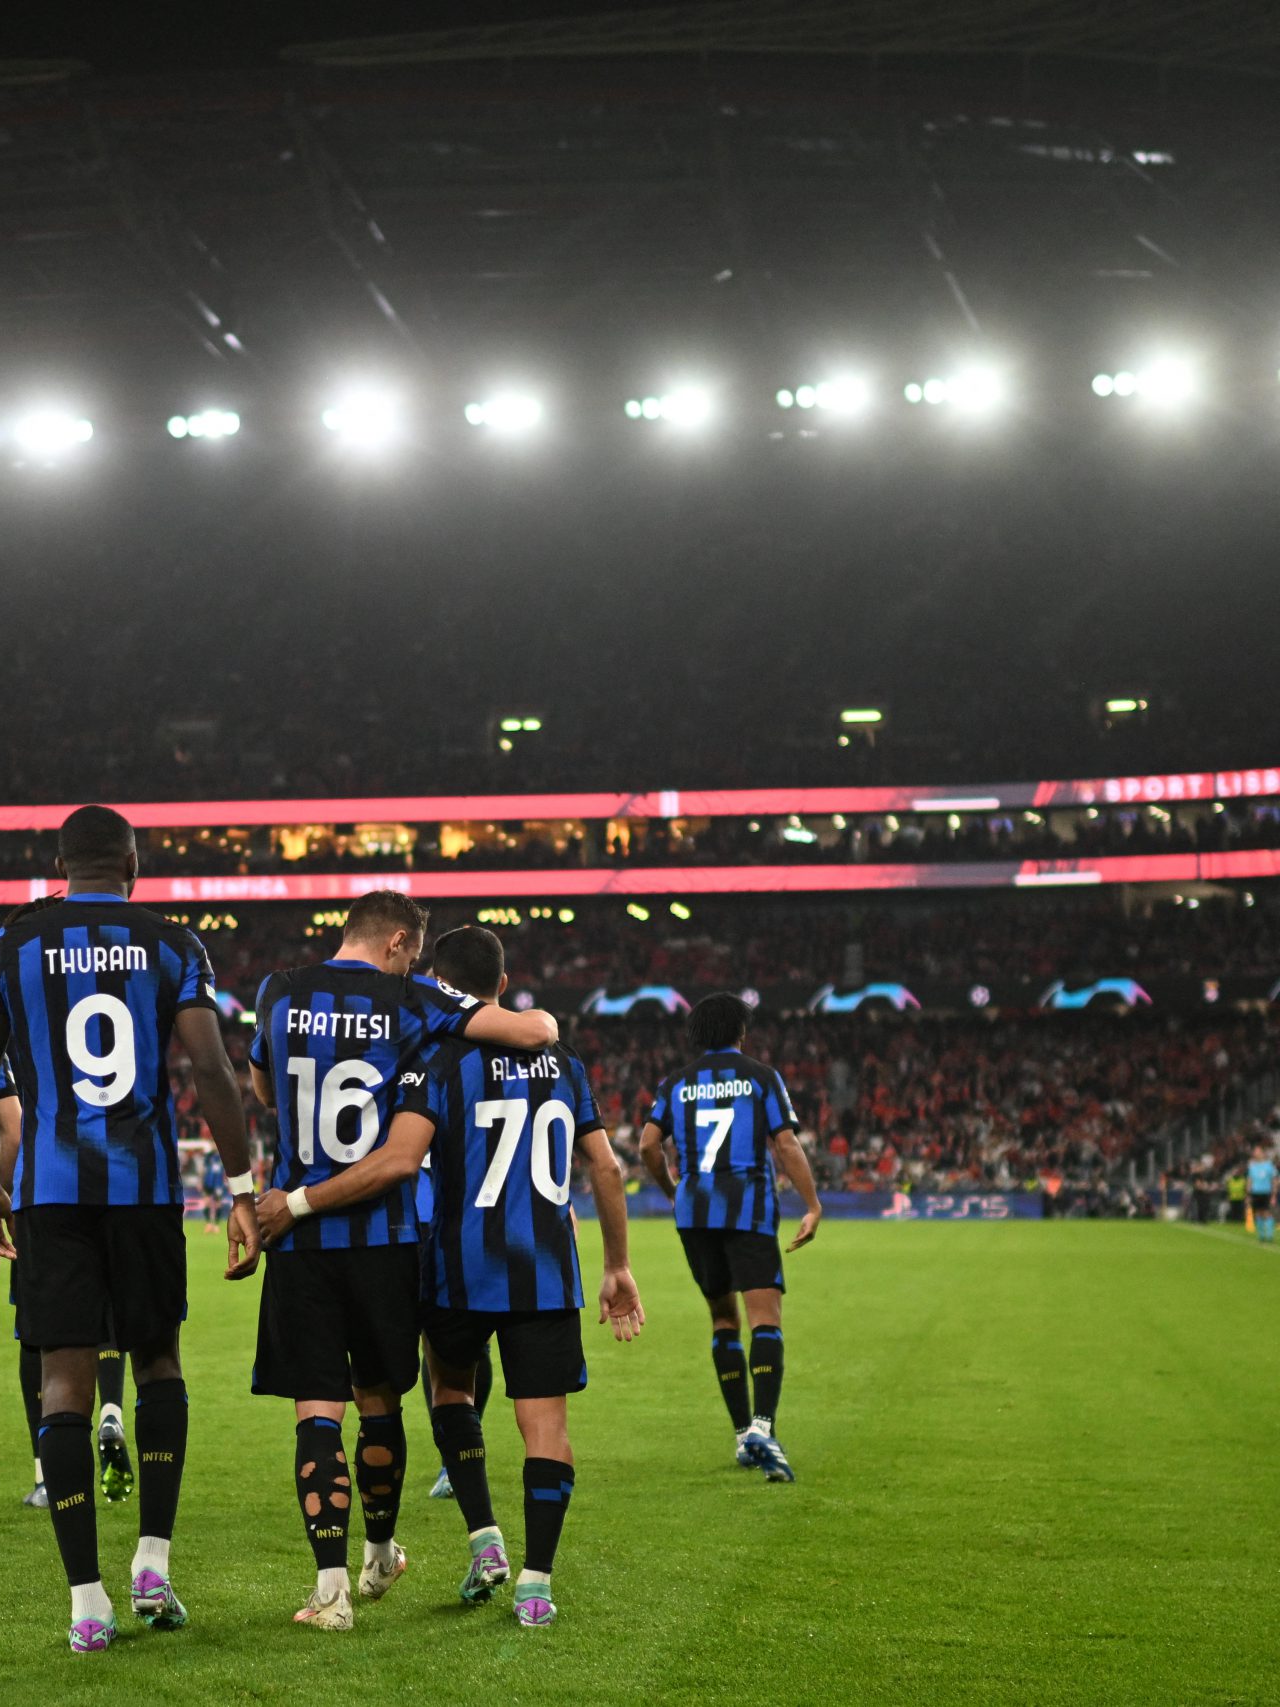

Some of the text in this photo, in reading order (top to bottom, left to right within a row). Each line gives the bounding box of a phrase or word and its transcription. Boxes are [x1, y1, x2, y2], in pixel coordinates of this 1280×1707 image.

[1105, 773, 1204, 803] SPORT
[45, 945, 147, 974] THURAM
[287, 1009, 390, 1039] FRATTESI
[66, 993, 136, 1107] 9
[491, 1056, 561, 1081] ALEXIS
[680, 1080, 752, 1103] CUADRADO
[287, 1056, 384, 1165] 16
[475, 1098, 575, 1206] 70
[696, 1108, 735, 1173] 7
[926, 1196, 1009, 1218] PS5
[99, 1350, 120, 1360] INTER
[143, 1452, 173, 1462] INTER
[459, 1448, 485, 1461] INTER
[56, 1493, 85, 1511] INTER
[316, 1528, 344, 1539] INTER
